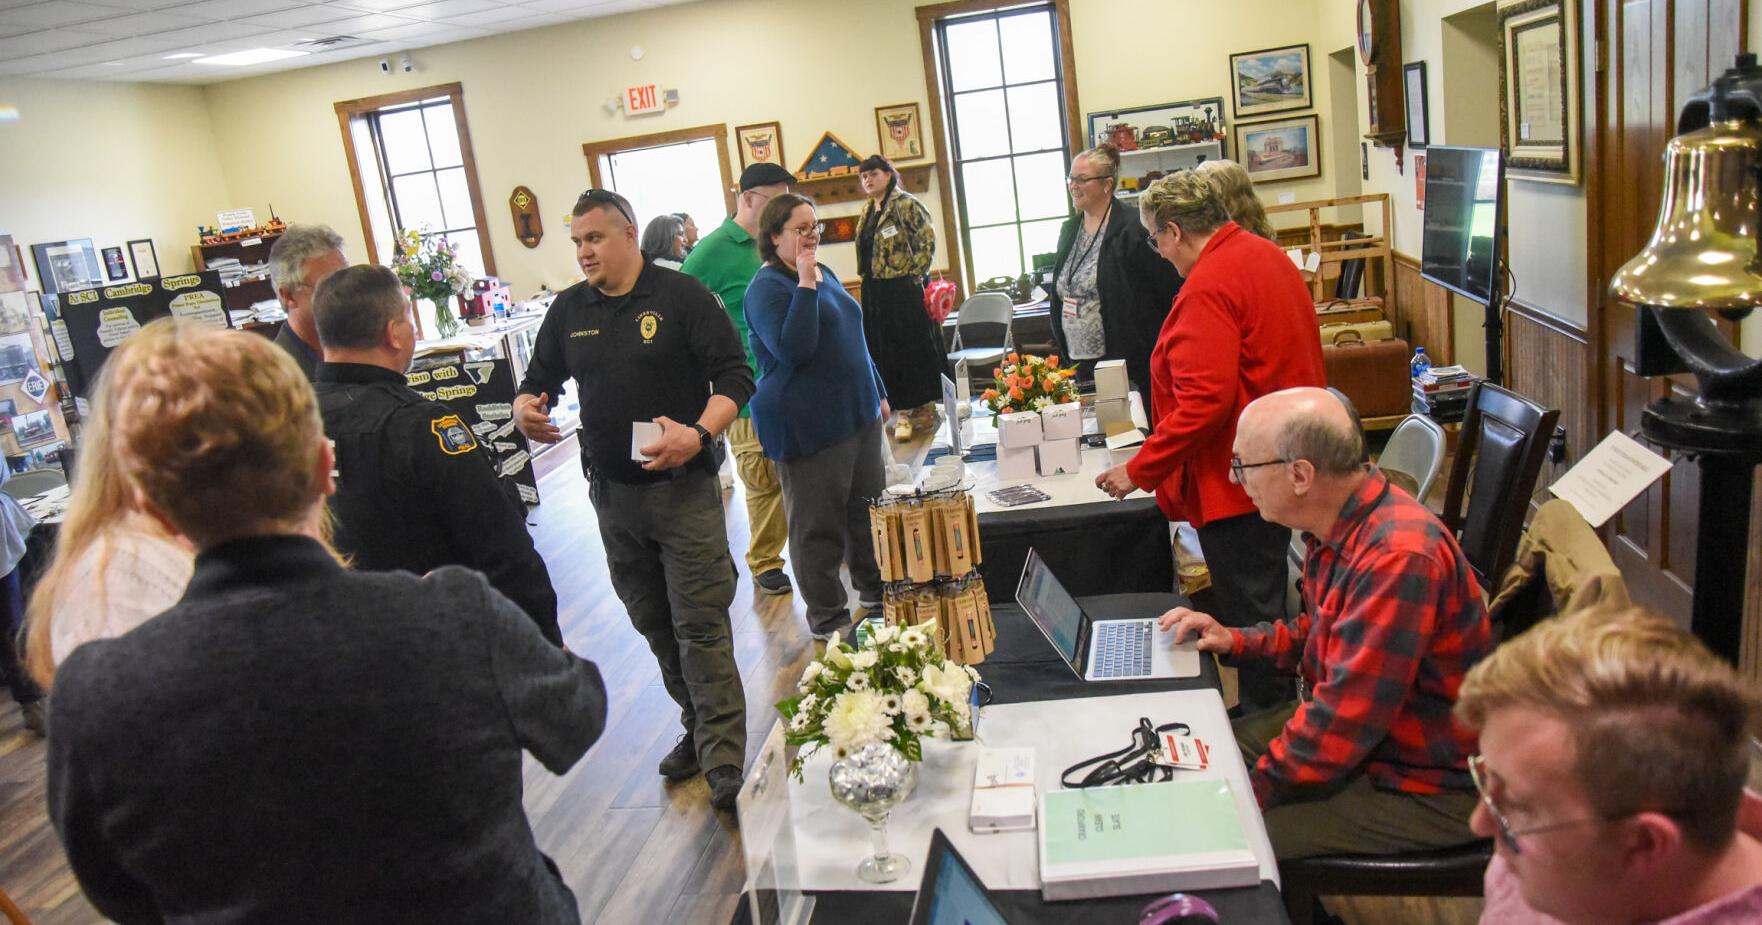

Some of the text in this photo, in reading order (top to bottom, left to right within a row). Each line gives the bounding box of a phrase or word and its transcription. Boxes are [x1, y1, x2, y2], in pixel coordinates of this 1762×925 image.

[629, 86, 656, 110] EXIT
[81, 292, 97, 302] SCI
[106, 284, 152, 298] Cambridge
[163, 275, 200, 288] Springs
[570, 329, 600, 338] JOHNSTON
[434, 368, 456, 378] with
[26, 380, 45, 392] ERIE
[438, 387, 476, 398] Springs
